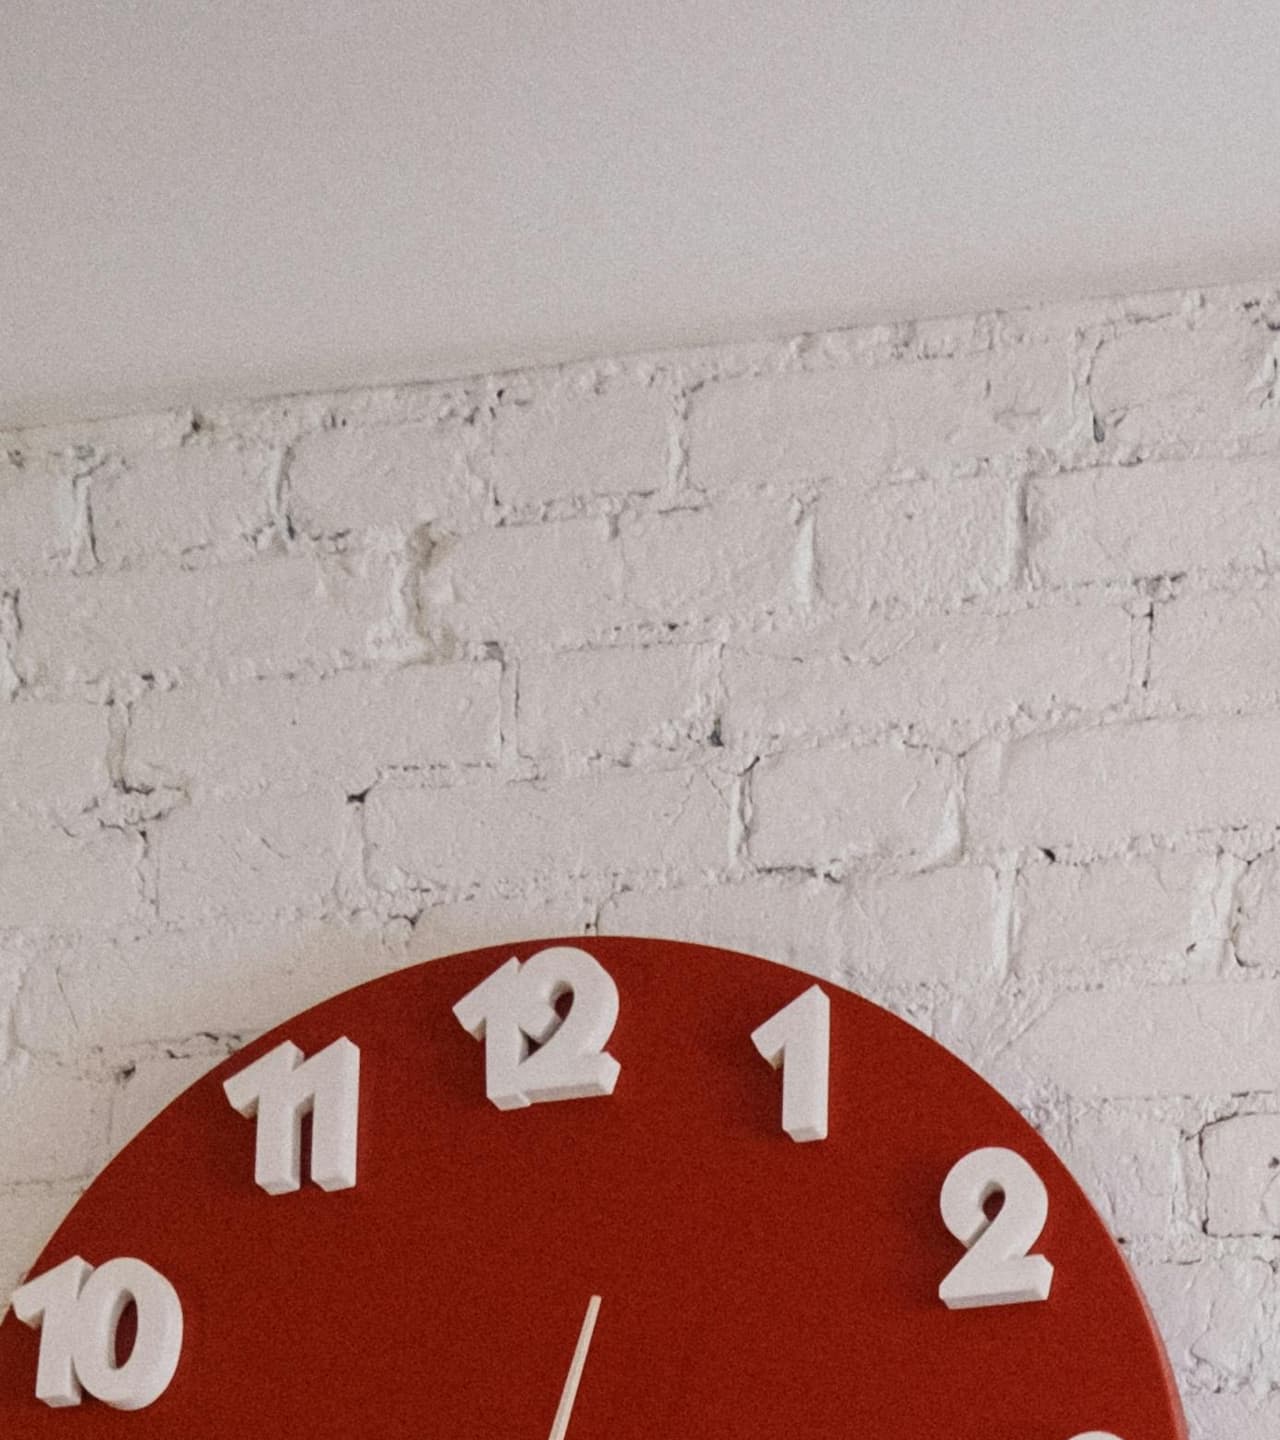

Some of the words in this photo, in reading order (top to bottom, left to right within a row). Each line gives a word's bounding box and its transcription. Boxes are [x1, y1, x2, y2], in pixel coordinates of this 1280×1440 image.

[453, 946, 620, 1110] 12
[751, 985, 829, 1142] 1
[223, 1036, 360, 1195] 11
[938, 1146, 1054, 1309] 2
[9, 1255, 184, 1411] 10
